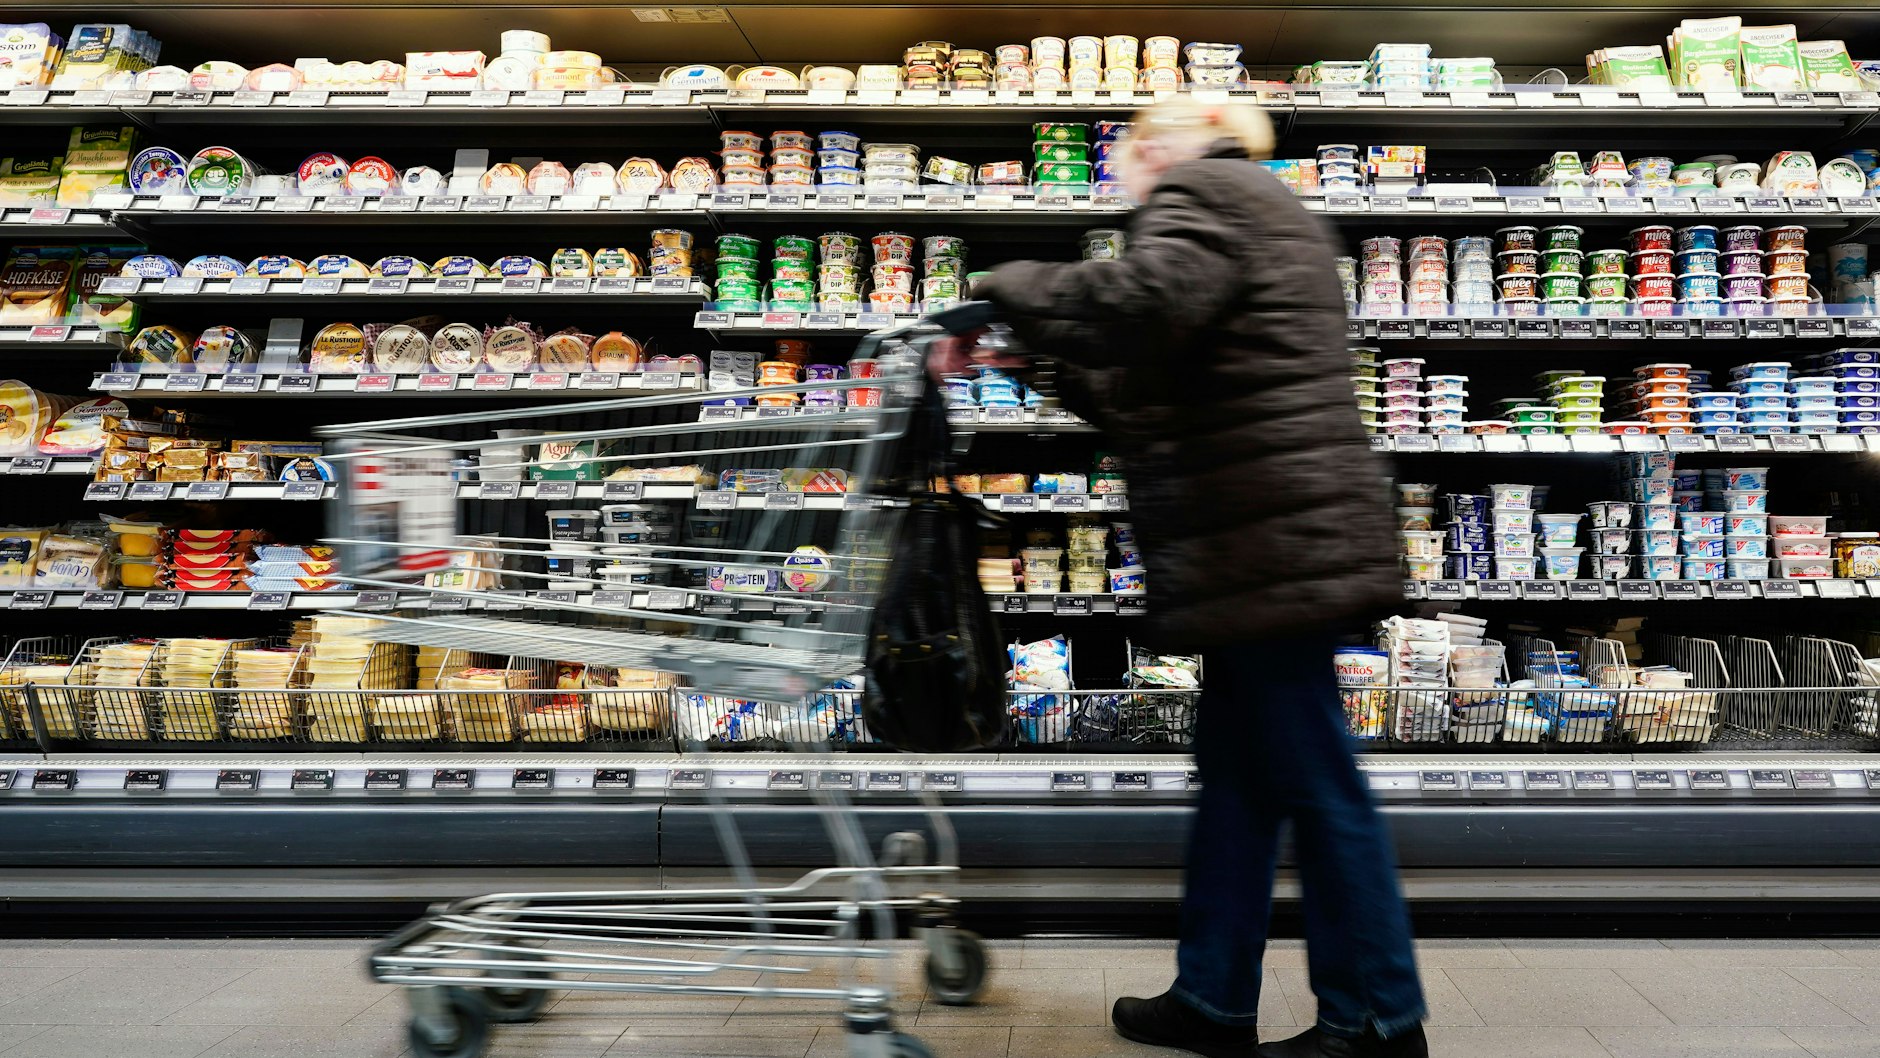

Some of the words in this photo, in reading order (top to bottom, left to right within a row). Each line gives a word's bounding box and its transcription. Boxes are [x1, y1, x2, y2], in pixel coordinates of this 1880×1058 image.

[1506, 230, 1534, 242] miree
[1551, 230, 1579, 241] miree
[1645, 230, 1671, 241] miree
[1726, 230, 1756, 241] miree
[1777, 229, 1804, 240] miree
[1422, 242, 1444, 250] BRESSO
[1462, 242, 1485, 250] BRESSO
[1592, 252, 1621, 265] miree
[1641, 254, 1670, 265] miree
[1689, 252, 1717, 264] miree
[1733, 254, 1760, 265] miree
[1775, 253, 1805, 264] miree
[1368, 263, 1389, 271] BRESSO
[1423, 262, 1444, 271] BRESSO
[1469, 263, 1490, 272] BRESSO
[7, 269, 63, 285] HOFKÄSE
[1552, 277, 1579, 288] miree
[1690, 276, 1718, 287] miree
[1777, 277, 1806, 288] miree
[1375, 284, 1397, 292] BRESSO
[1419, 283, 1440, 291] BRESSO
[1472, 283, 1492, 292] BRESSO
[1503, 278, 1532, 289] miree
[1589, 277, 1616, 289] miree
[1645, 278, 1672, 288] miree
[1730, 277, 1760, 289] miree
[1643, 301, 1672, 312] miree
[329, 336, 362, 344] RUSTIQUE
[441, 328, 450, 338] LE
[447, 333, 464, 351] RUST
[866, 398, 879, 407] XXL
[794, 556, 815, 564] Quäse
[50, 562, 90, 578] GOUDA
[1336, 666, 1373, 676] PATROS
